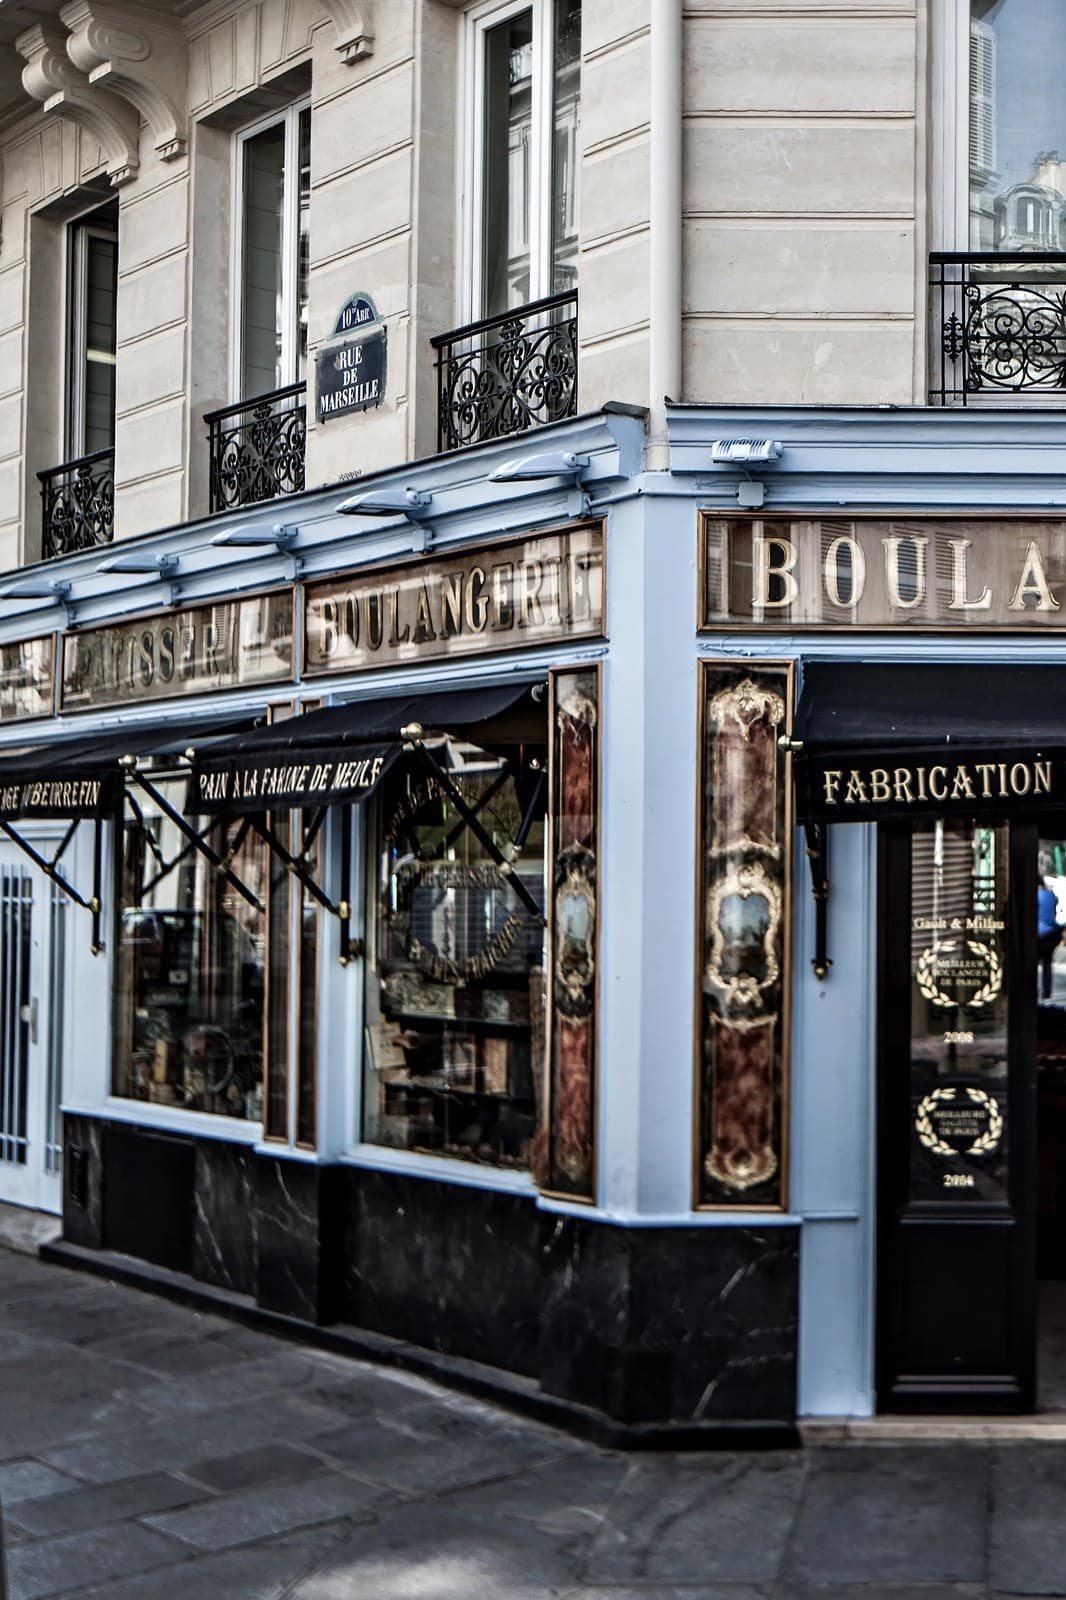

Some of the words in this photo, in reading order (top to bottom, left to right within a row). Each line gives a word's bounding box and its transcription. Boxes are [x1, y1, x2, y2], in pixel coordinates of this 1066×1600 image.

[339, 345, 362, 370] RUE
[343, 367, 358, 386] DE
[320, 379, 379, 414] MARSEILLE
[313, 556, 592, 657] BOULANGERIE
[79, 780, 101, 807] FIN
[200, 772, 229, 801] PAIN
[243, 768, 259, 798] LA
[260, 765, 310, 796] FARINE
[309, 764, 333, 792] DE
[822, 760, 1053, 805] FABRICATION
[950, 918, 962, 929] &
[965, 918, 1005, 929] Millau
